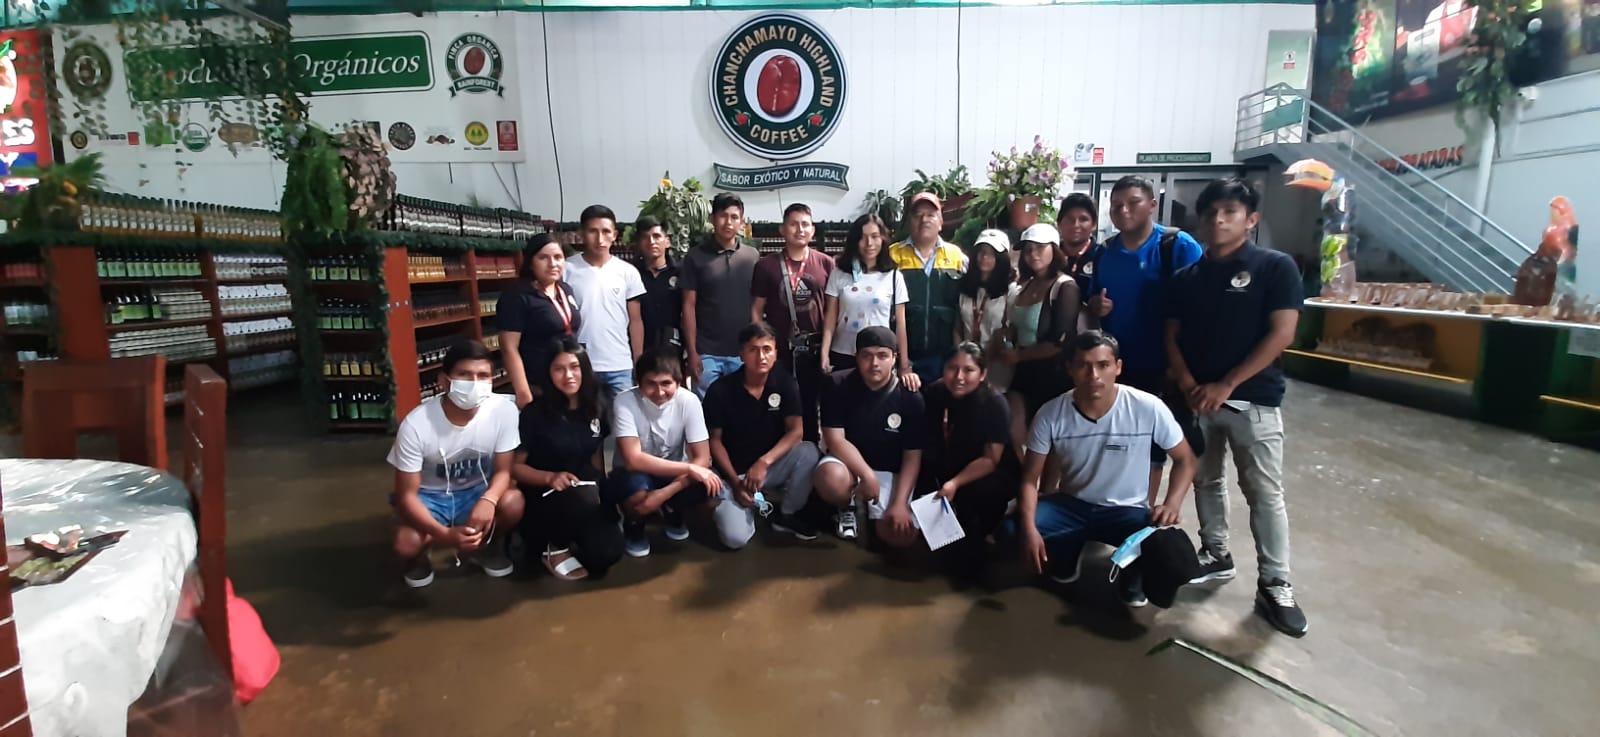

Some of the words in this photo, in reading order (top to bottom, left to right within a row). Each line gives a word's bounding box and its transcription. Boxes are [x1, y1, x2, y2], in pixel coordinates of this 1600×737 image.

[722, 25, 797, 107] CHANCHAMAYO
[798, 33, 836, 108] HIGHLAND
[749, 124, 809, 145] COFFEE
[721, 172, 750, 185] SABOR
[753, 168, 790, 185] EXÓTICO
[793, 167, 800, 179] Y
[802, 167, 842, 182] NATURAL
